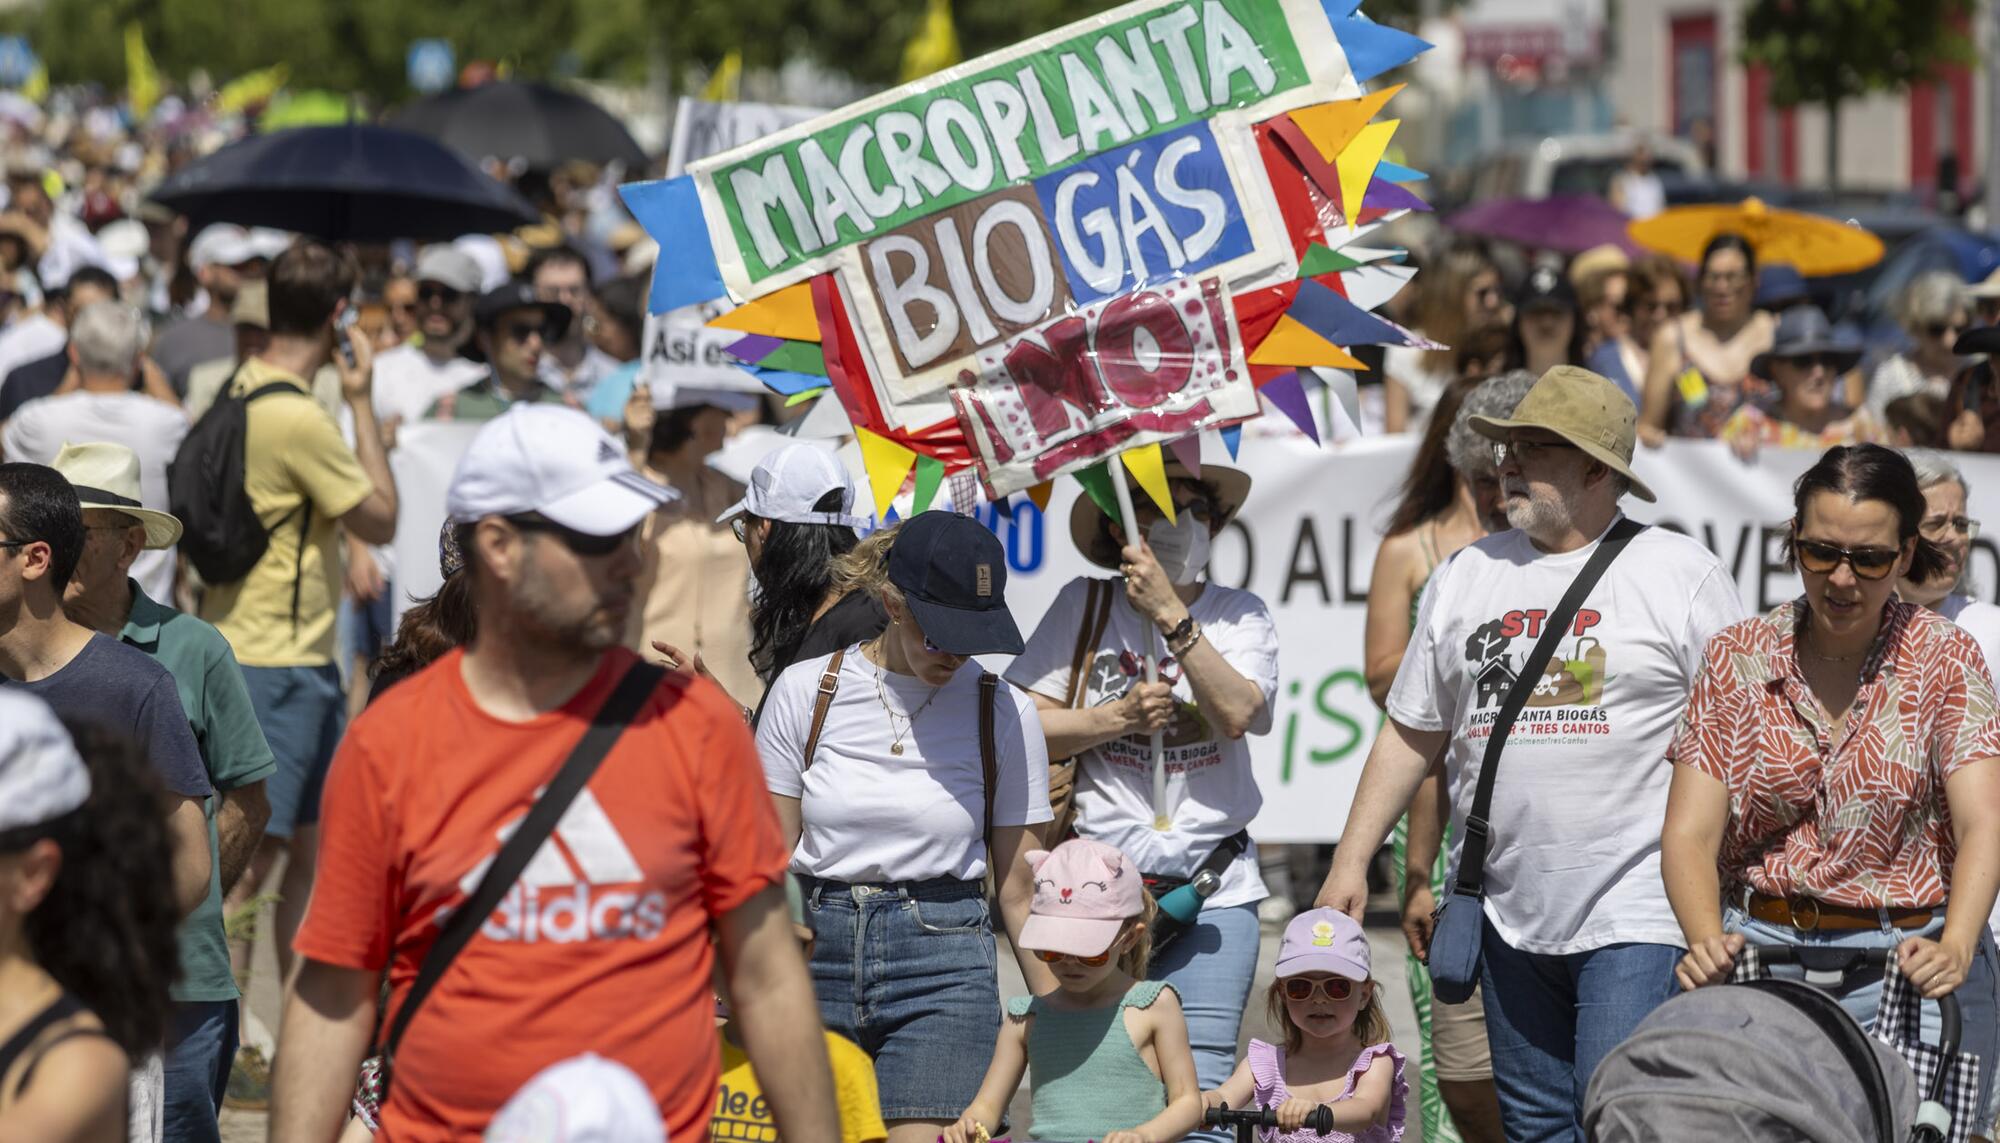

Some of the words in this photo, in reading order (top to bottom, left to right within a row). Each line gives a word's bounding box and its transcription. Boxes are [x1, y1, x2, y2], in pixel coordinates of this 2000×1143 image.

[729, 1, 1277, 271] MACROPLANTA
[1500, 609, 1602, 639] STP
[1530, 723, 1558, 735] TRES
[1562, 722, 1610, 735] CANTOS
[1556, 706, 1607, 721] BIOGÁS
[434, 882, 666, 943] didas
